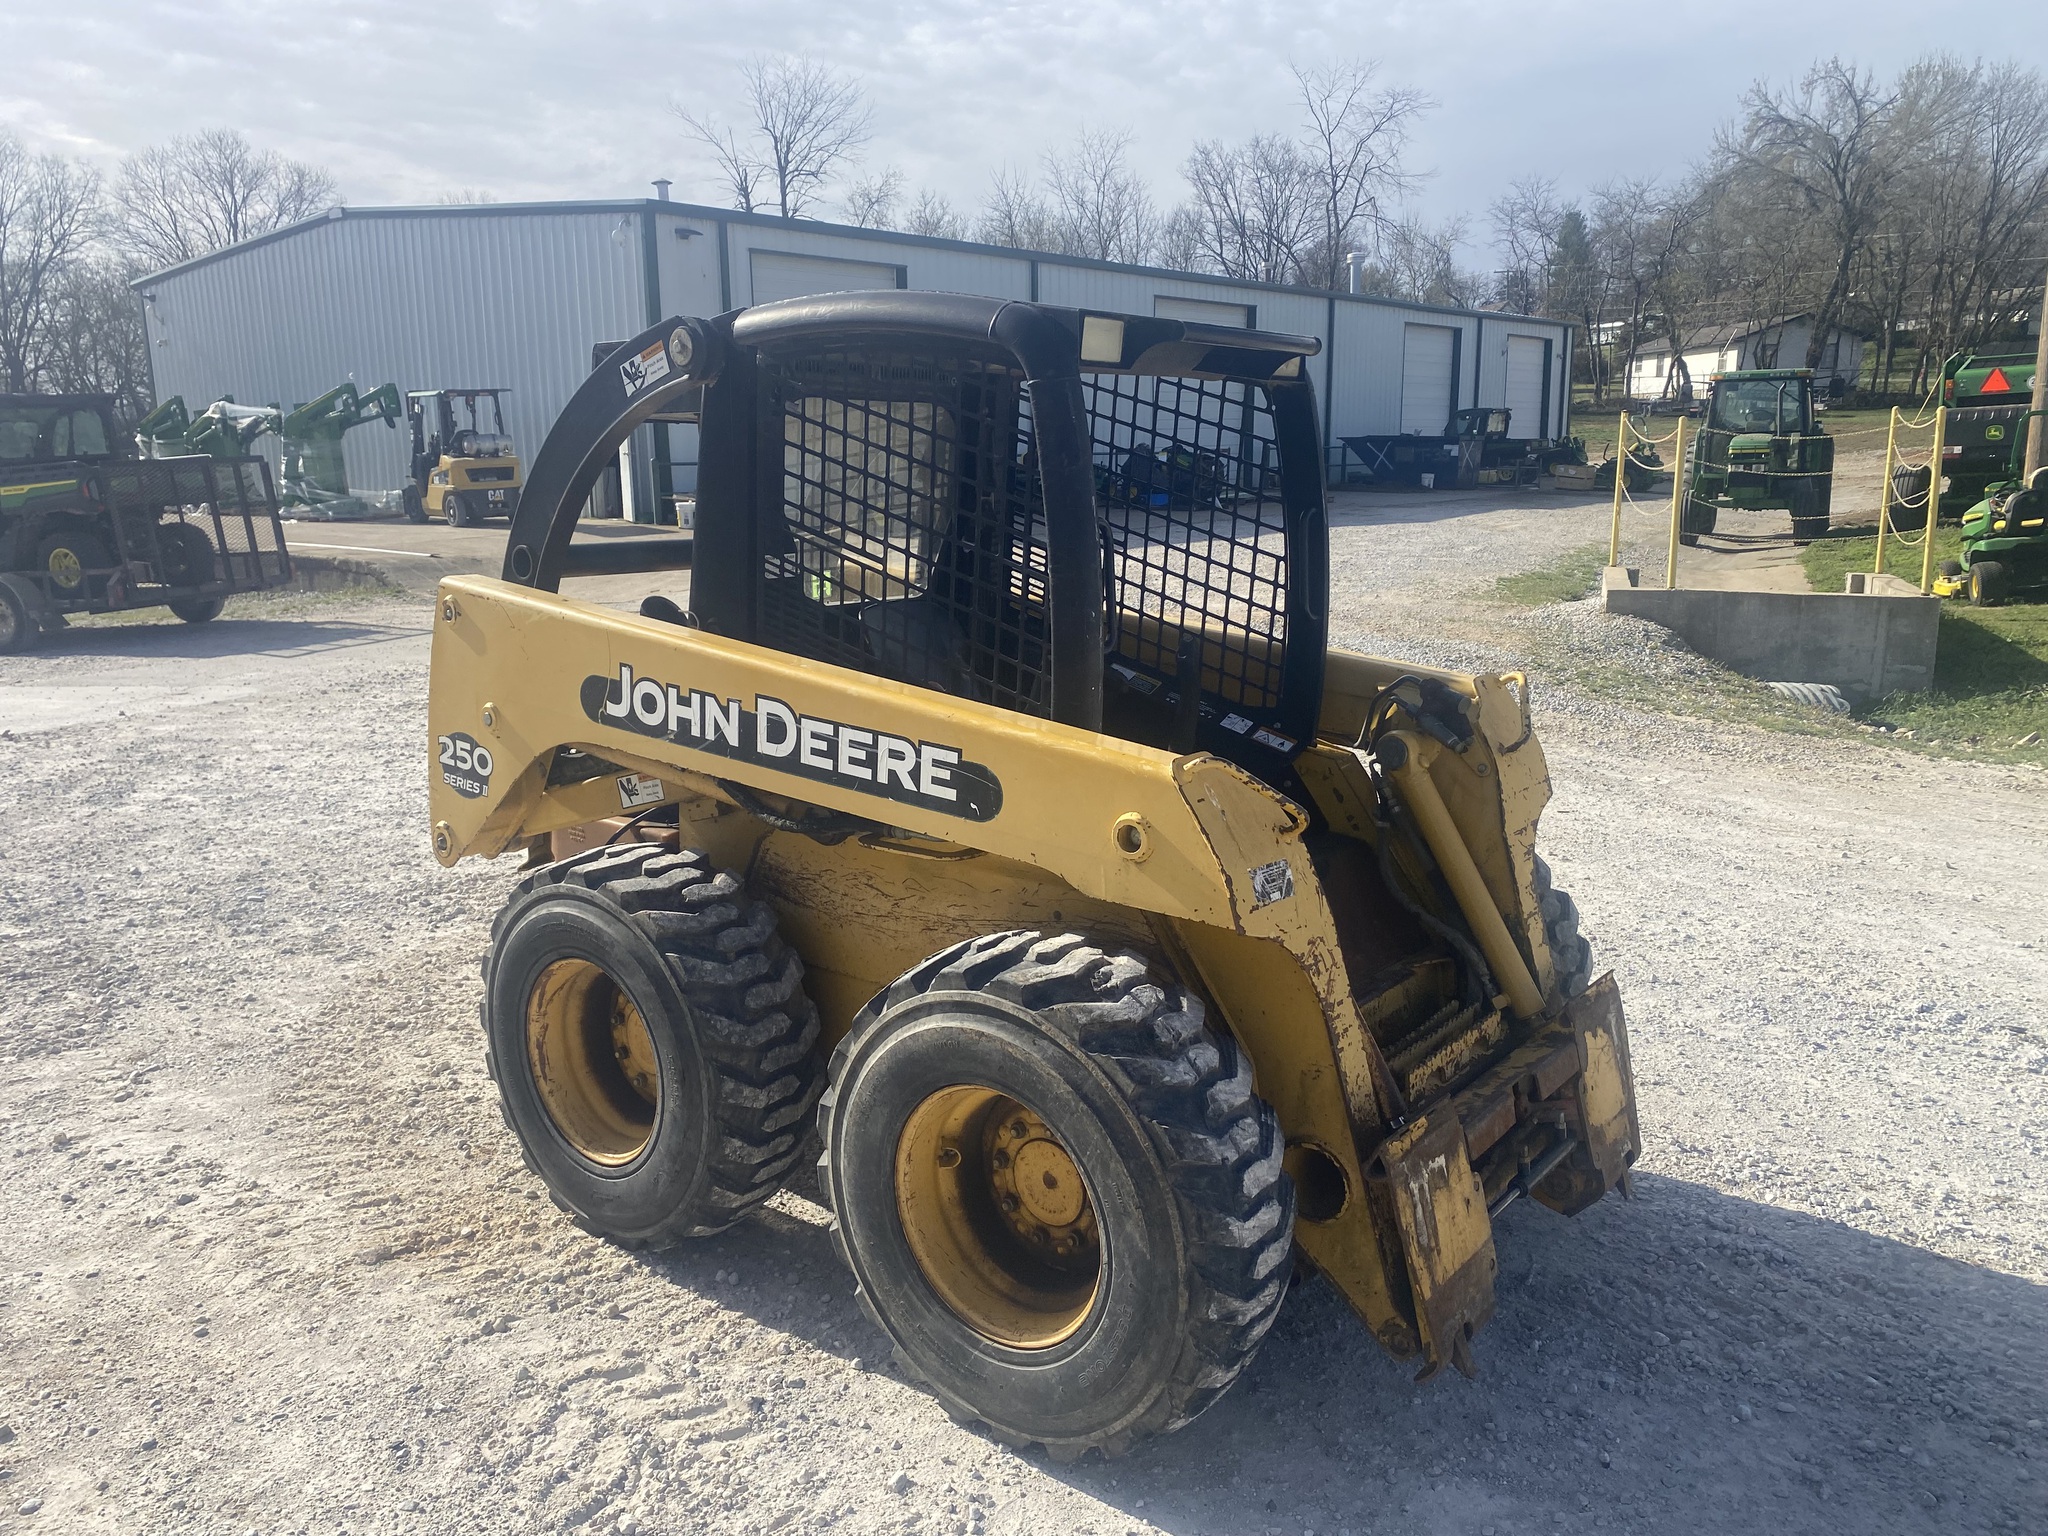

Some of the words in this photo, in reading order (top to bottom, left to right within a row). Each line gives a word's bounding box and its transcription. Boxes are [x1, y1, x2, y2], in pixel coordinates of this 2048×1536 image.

[487, 489, 505, 501] CAT
[606, 665, 739, 748] JOHN
[756, 697, 959, 802] DEERE
[438, 735, 493, 777] 250
[443, 772, 480, 794] SERIES
